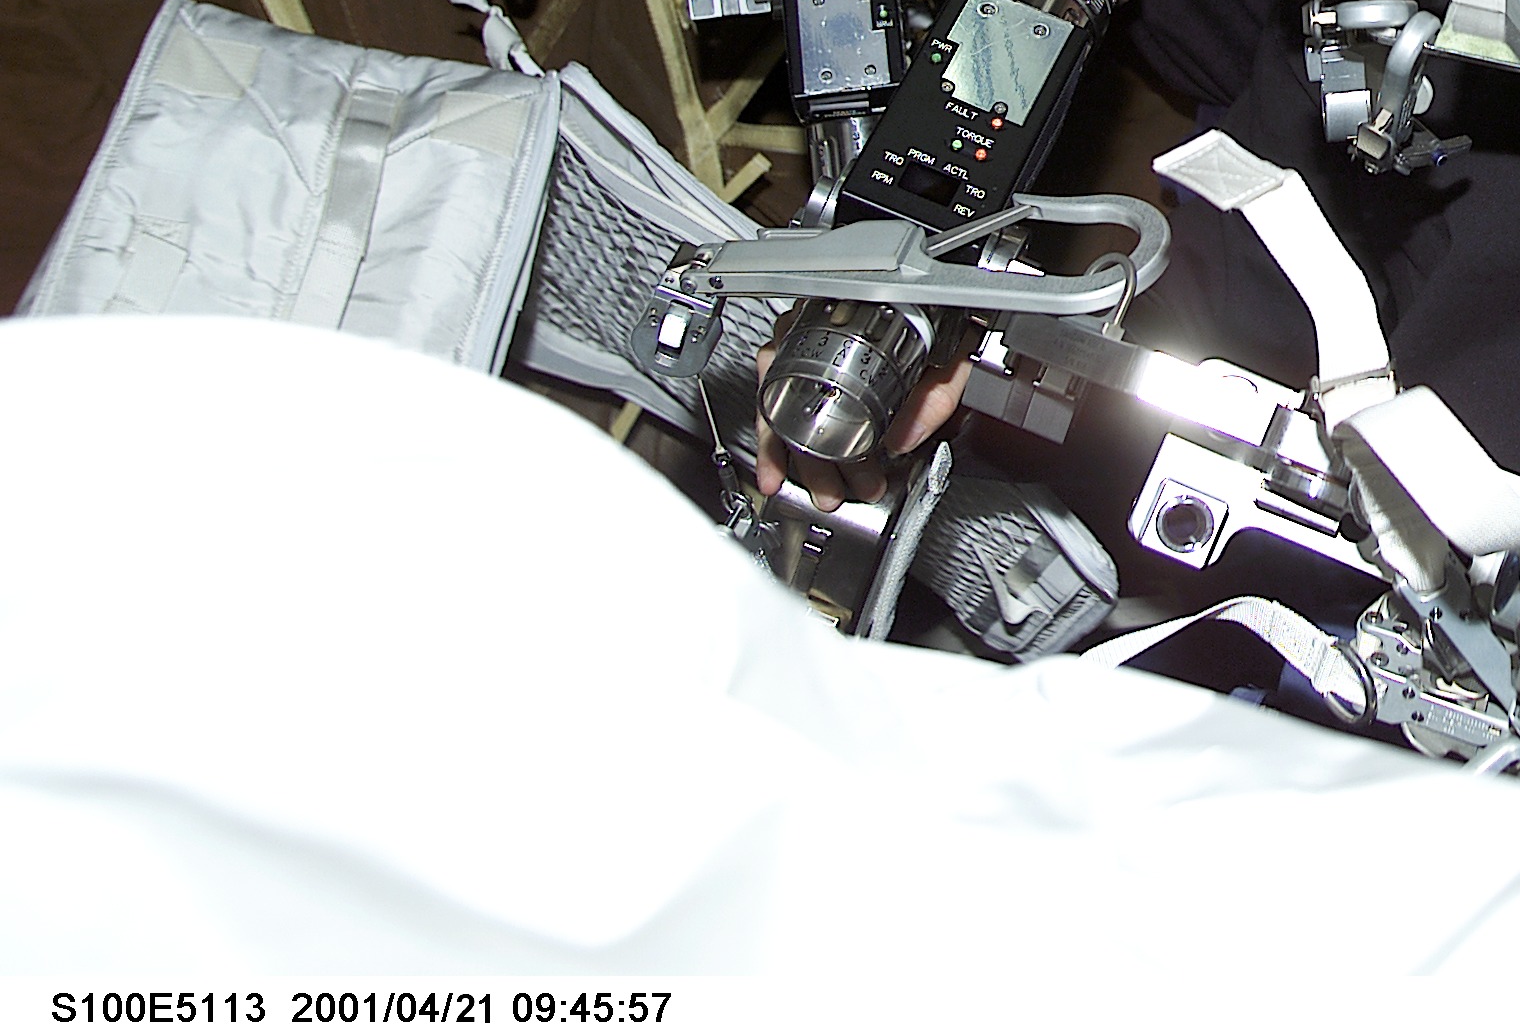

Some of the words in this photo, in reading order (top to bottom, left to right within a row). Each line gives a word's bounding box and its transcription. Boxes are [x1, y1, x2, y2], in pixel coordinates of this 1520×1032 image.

[930, 38, 953, 54] PWR
[944, 101, 979, 121] FAULT
[955, 125, 995, 149] TORQUE
[906, 147, 937, 166] PRGM
[870, 169, 894, 186] RPM
[942, 162, 970, 181] ACTL
[952, 203, 976, 219] REV
